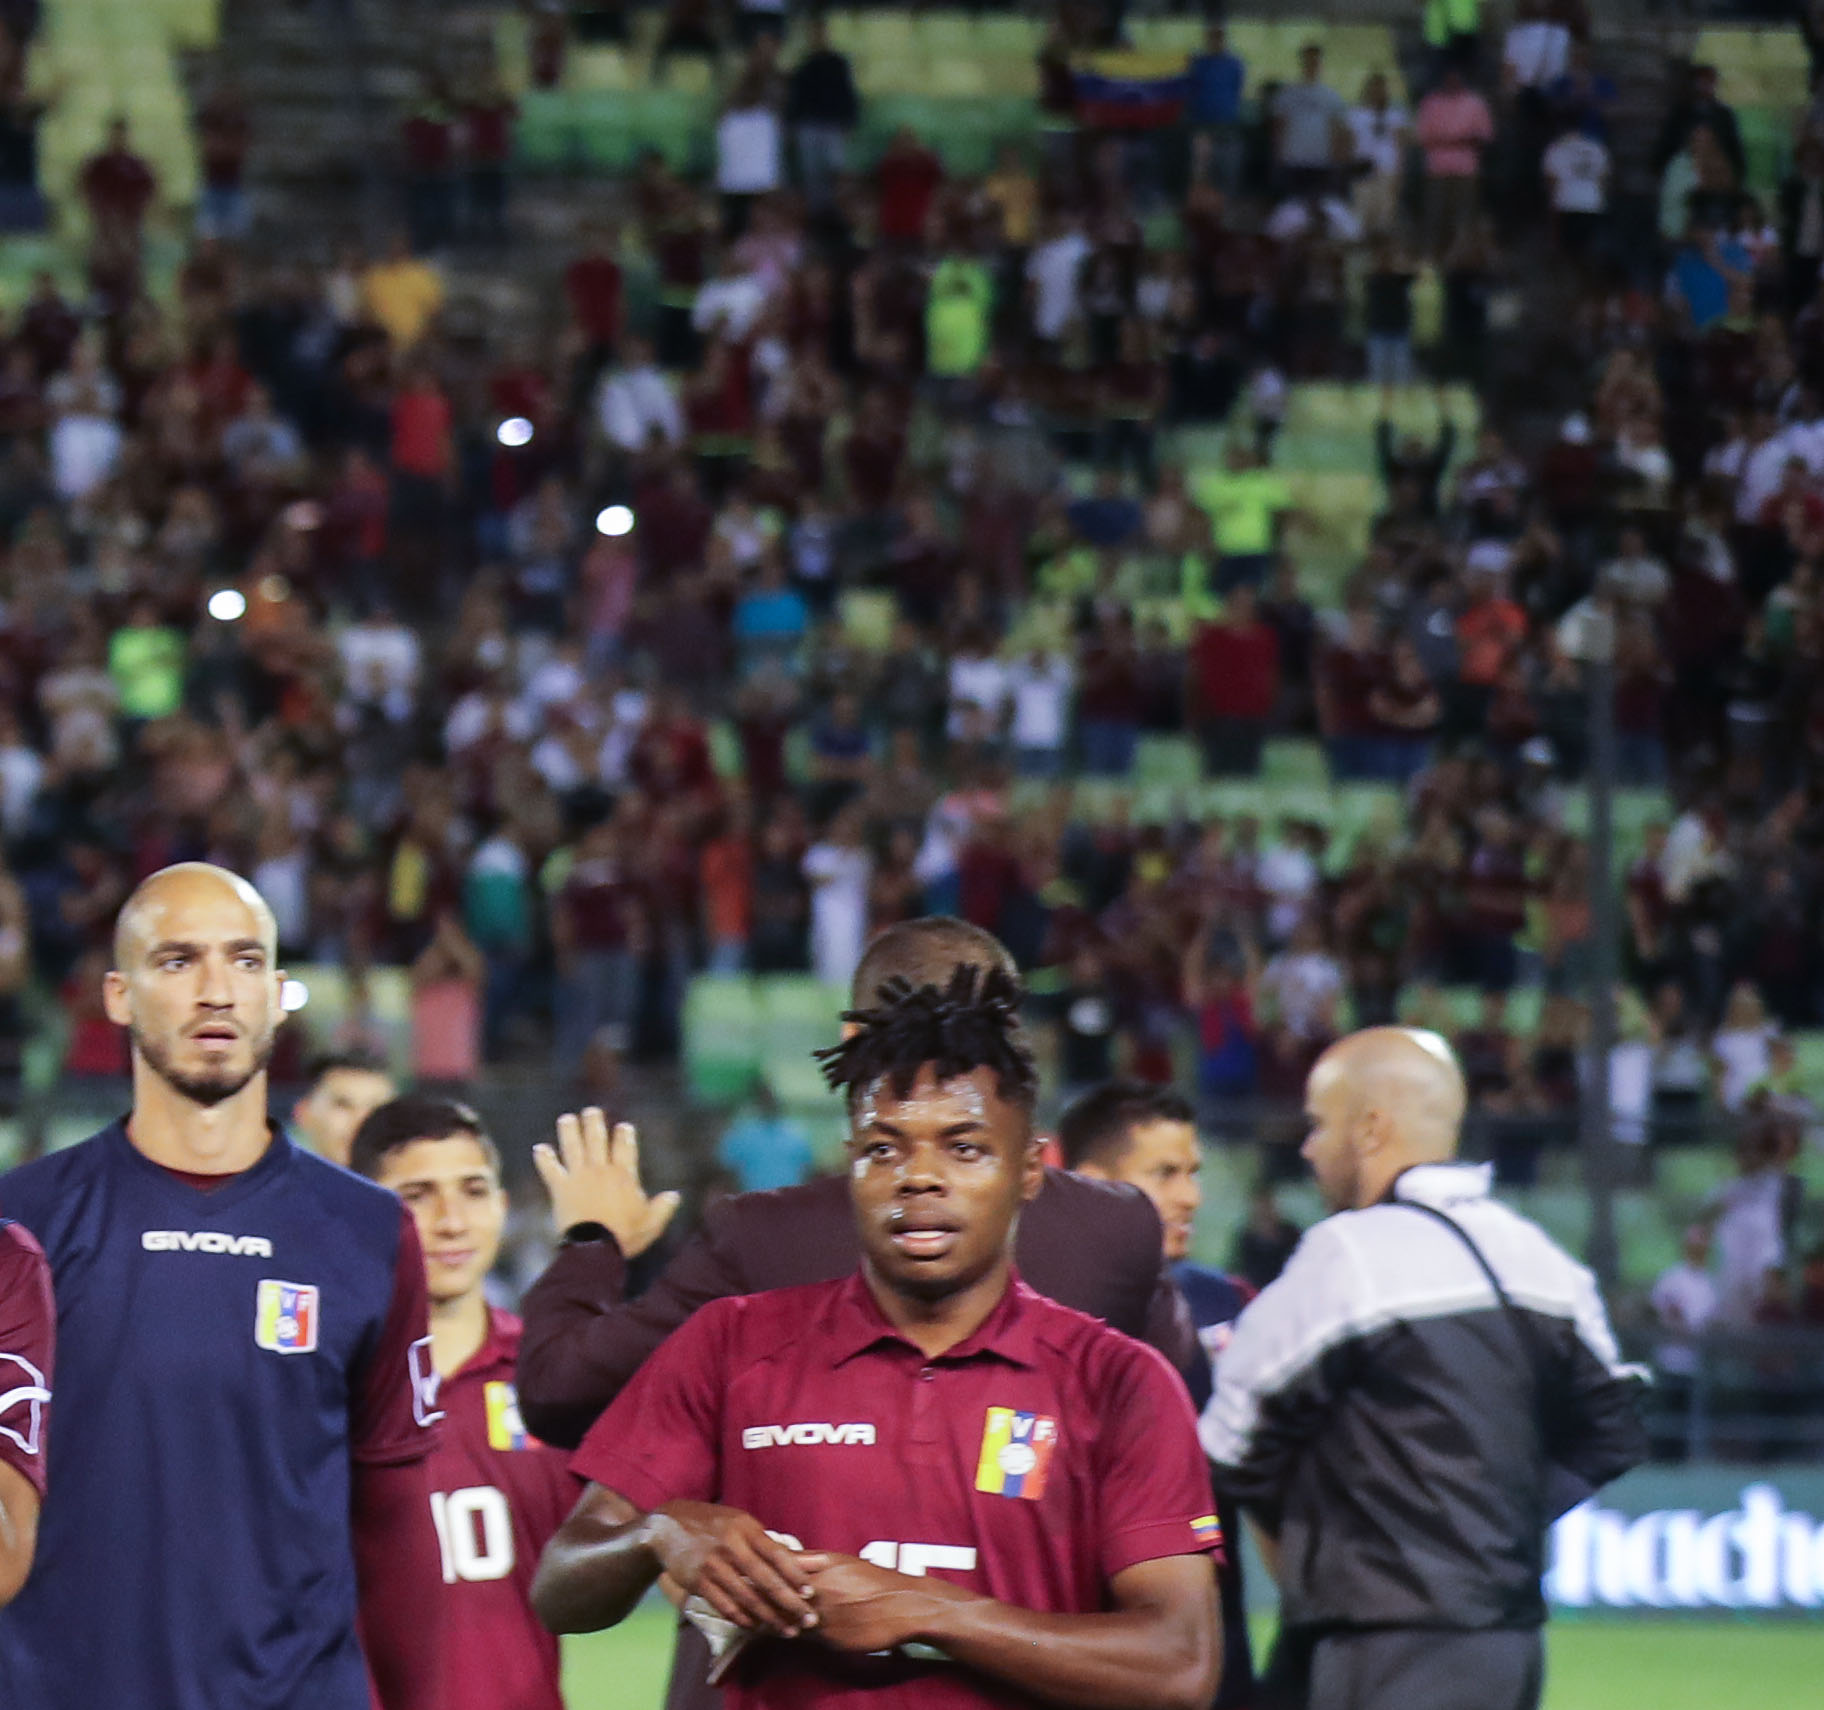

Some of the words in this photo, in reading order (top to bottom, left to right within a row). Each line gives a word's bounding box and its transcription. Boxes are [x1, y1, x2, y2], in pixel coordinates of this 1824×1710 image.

[141, 1229, 273, 1259] GIVOVA
[742, 1422, 877, 1451] GIVOVA
[429, 1485, 516, 1585] 10
